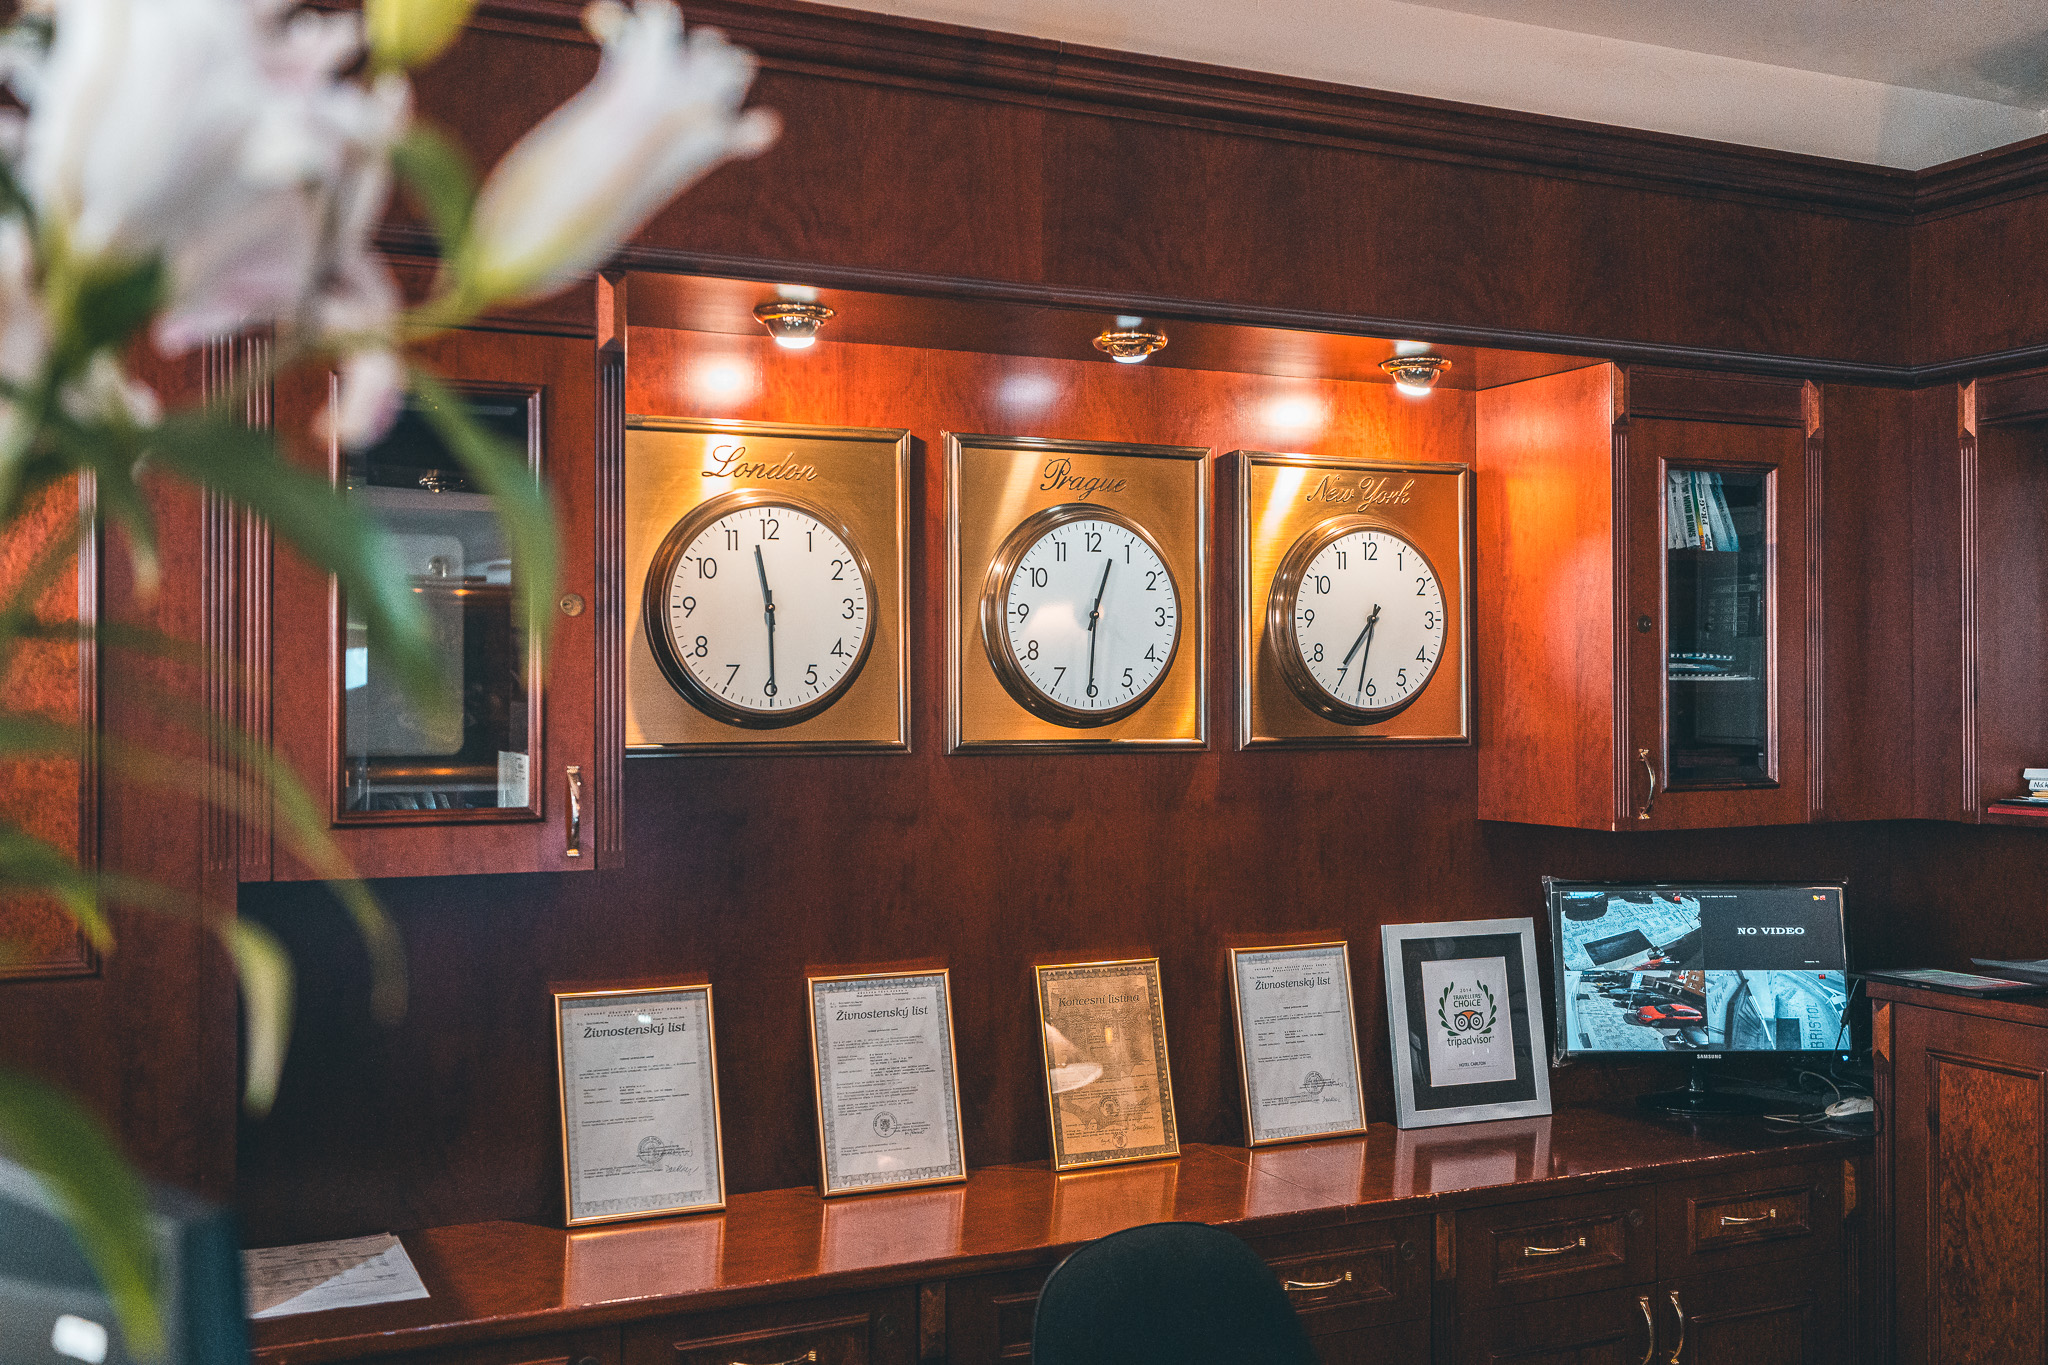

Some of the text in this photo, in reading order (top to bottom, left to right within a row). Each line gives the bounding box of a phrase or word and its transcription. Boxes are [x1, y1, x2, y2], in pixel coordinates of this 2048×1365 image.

[702, 445, 818, 482] London
[1040, 457, 1127, 501] Prague
[1306, 474, 1415, 512] New York
[1683, 495, 1693, 514] WIND
[760, 519, 779, 539] 12
[1686, 515, 1696, 538] BLOWS
[725, 530, 738, 551] 11
[806, 532, 812, 552] 1
[1085, 533, 1101, 552] 12
[1055, 542, 1066, 561] 11
[1125, 545, 1130, 563] 1
[1363, 542, 1377, 560] 12
[696, 557, 717, 579] 10
[831, 560, 843, 580] 2
[1336, 552, 1346, 570] 11
[1398, 553, 1403, 571] 1
[1030, 568, 1047, 587] 10
[1146, 571, 1156, 591] 2
[1315, 576, 1330, 594] 10
[1416, 578, 1425, 596] 2
[682, 597, 696, 618] 9
[842, 598, 854, 619] 3
[1018, 604, 1029, 623] 9
[1155, 608, 1165, 626] 3
[1304, 609, 1314, 627] 9
[1425, 612, 1434, 629] 3
[695, 637, 708, 657] 8
[831, 638, 844, 657] 4
[1028, 640, 1038, 660] 8
[1144, 644, 1155, 662] 4
[1314, 644, 1323, 662] 8
[1416, 646, 1426, 662] 4
[726, 665, 739, 685] 7
[804, 665, 818, 685] 5
[1054, 667, 1066, 686] 7
[1122, 668, 1132, 687] 5
[1337, 668, 1347, 686] 7
[1396, 669, 1406, 686] 5
[1366, 678, 1376, 696] 6
[1737, 927, 1805, 935] NO VIDEO
[1255, 977, 1331, 990] Živnostenský list
[1059, 993, 1140, 1007] Koncesní listina
[1453, 999, 1481, 1008] CHOICE
[836, 1005, 928, 1021] Živnostenský list
[583, 1023, 664, 1039] Živnostenský
[668, 1022, 686, 1032] list
[1806, 1002, 1824, 1049] BRISTOL
[1447, 1035, 1492, 1048] tripadvisor
